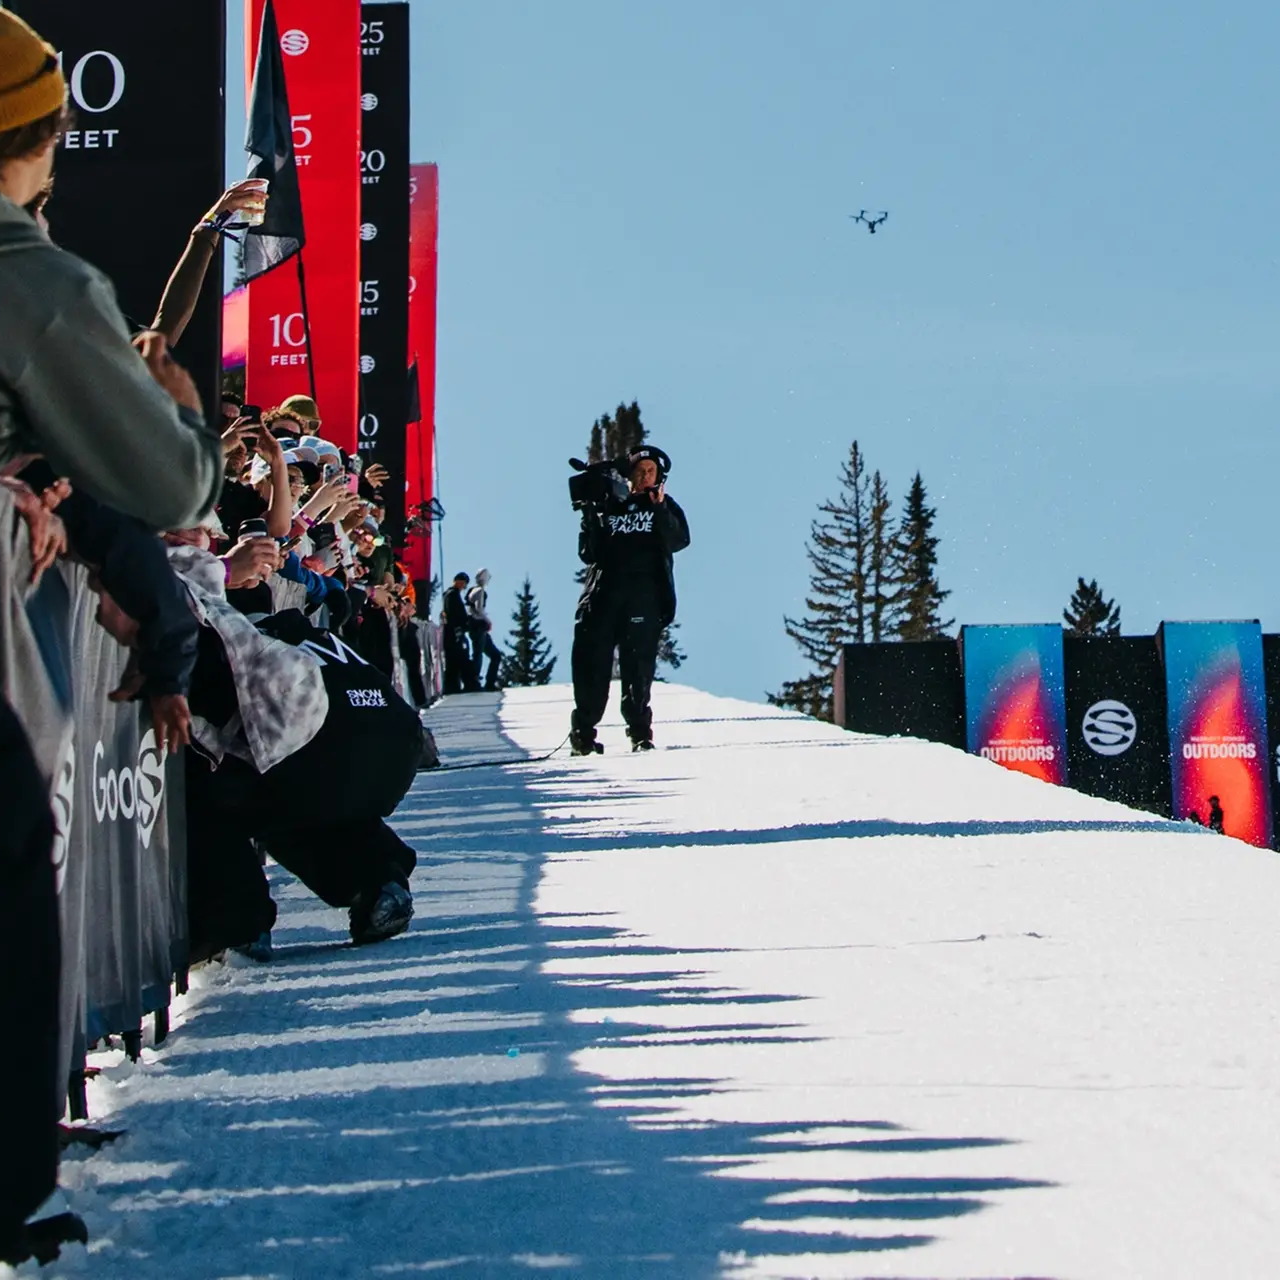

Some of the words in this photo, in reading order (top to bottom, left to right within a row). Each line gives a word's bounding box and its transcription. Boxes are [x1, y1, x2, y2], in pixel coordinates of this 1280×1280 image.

[56, 51, 125, 113] 0
[291, 114, 312, 148] 5
[295, 155, 311, 166] ET
[363, 176, 379, 184] EET
[360, 307, 378, 315] EET
[269, 313, 311, 347] 10
[271, 354, 308, 365] FEET
[359, 441, 376, 449] EET
[608, 511, 654, 525] SNOW
[346, 689, 382, 698] SNOW
[350, 697, 388, 706] LEAGUE
[981, 746, 1054, 761] OUTDOORS
[1183, 743, 1256, 759] OUTDOORS
